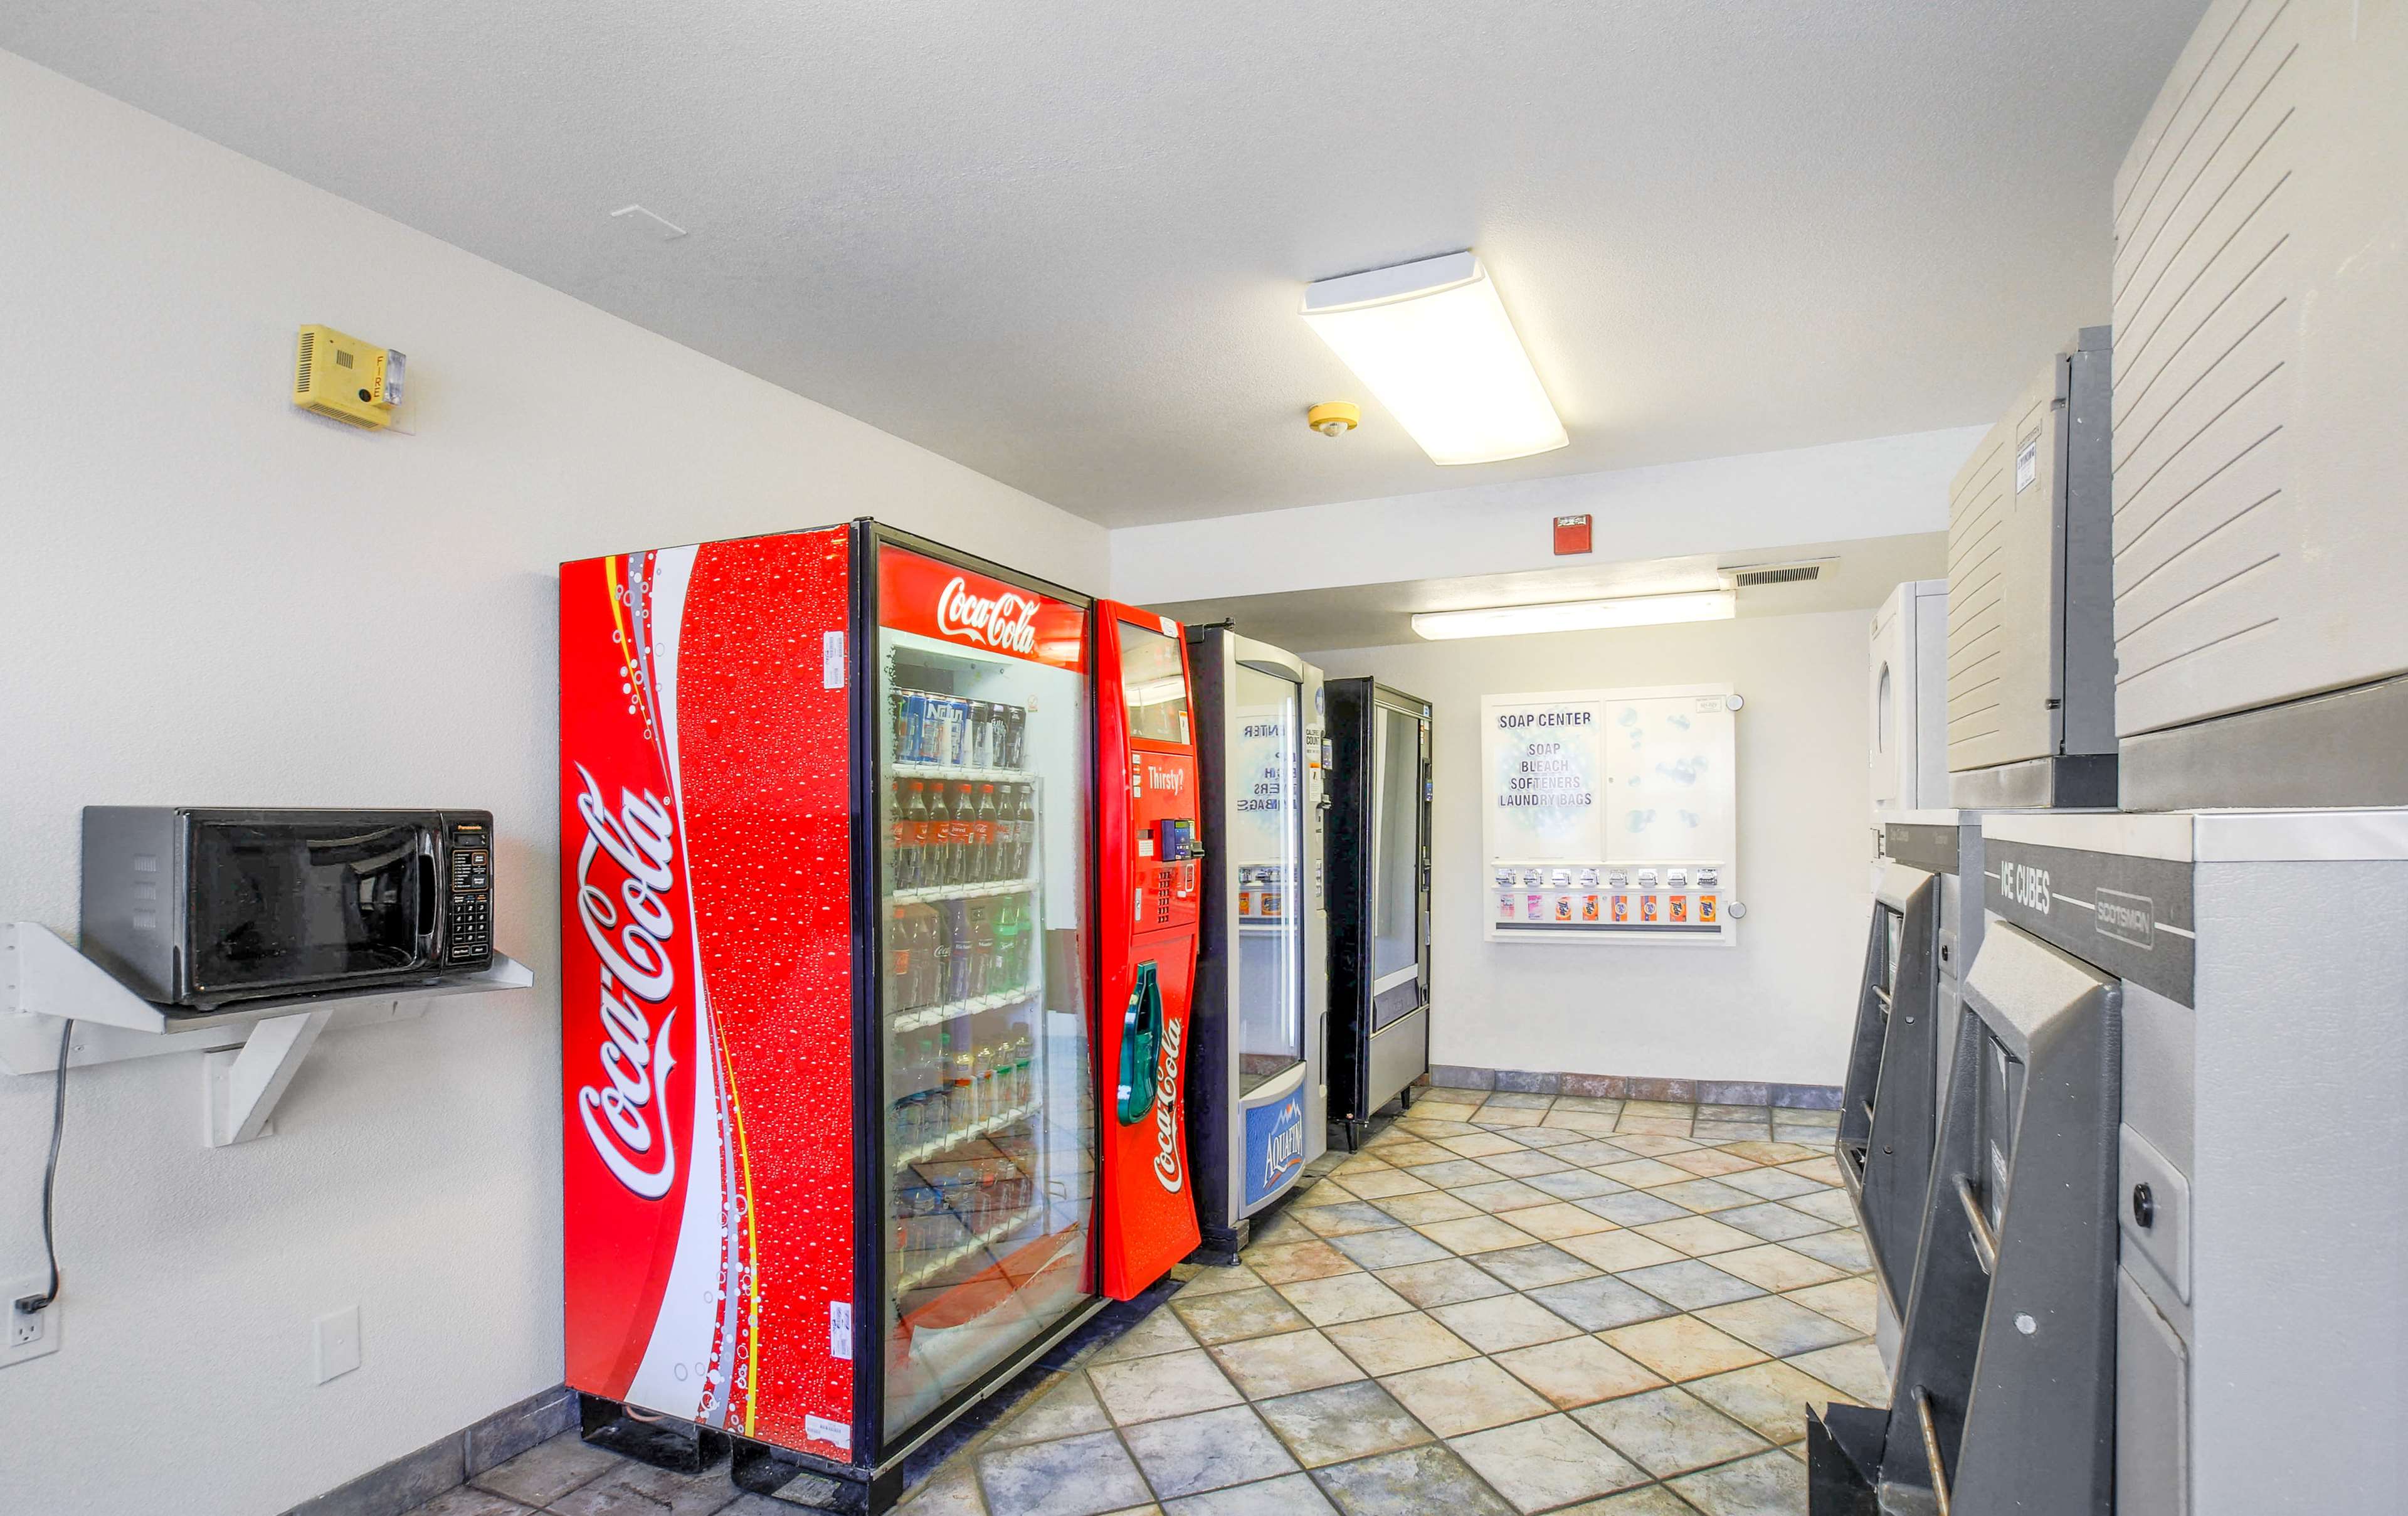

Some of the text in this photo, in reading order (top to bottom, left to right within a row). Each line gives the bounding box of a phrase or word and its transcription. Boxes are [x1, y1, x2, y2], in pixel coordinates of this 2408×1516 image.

[374, 356, 384, 397] FIRE
[937, 576, 1040, 654] Coca-Cola
[1500, 712, 1591, 728] SOAP CENTER
[1529, 743, 1560, 755] SOAP
[1521, 760, 1568, 772] BLEACH
[1148, 766, 1184, 796] Thirsty?
[1511, 777, 1580, 789] SOFTENERS
[1500, 793, 1592, 806] LAUNDRY BAGS
[2002, 861, 2049, 914] ICE CUBES
[1558, 901, 1569, 916] Tide
[1586, 902, 1594, 914] Tide
[1671, 903, 1682, 916] Tide
[1701, 902, 1713, 916] Tide
[2098, 902, 2150, 933] SCOTSMAN
[574, 760, 677, 1199] Coca-Cola
[1153, 1017, 1182, 1192] Coca-Cola
